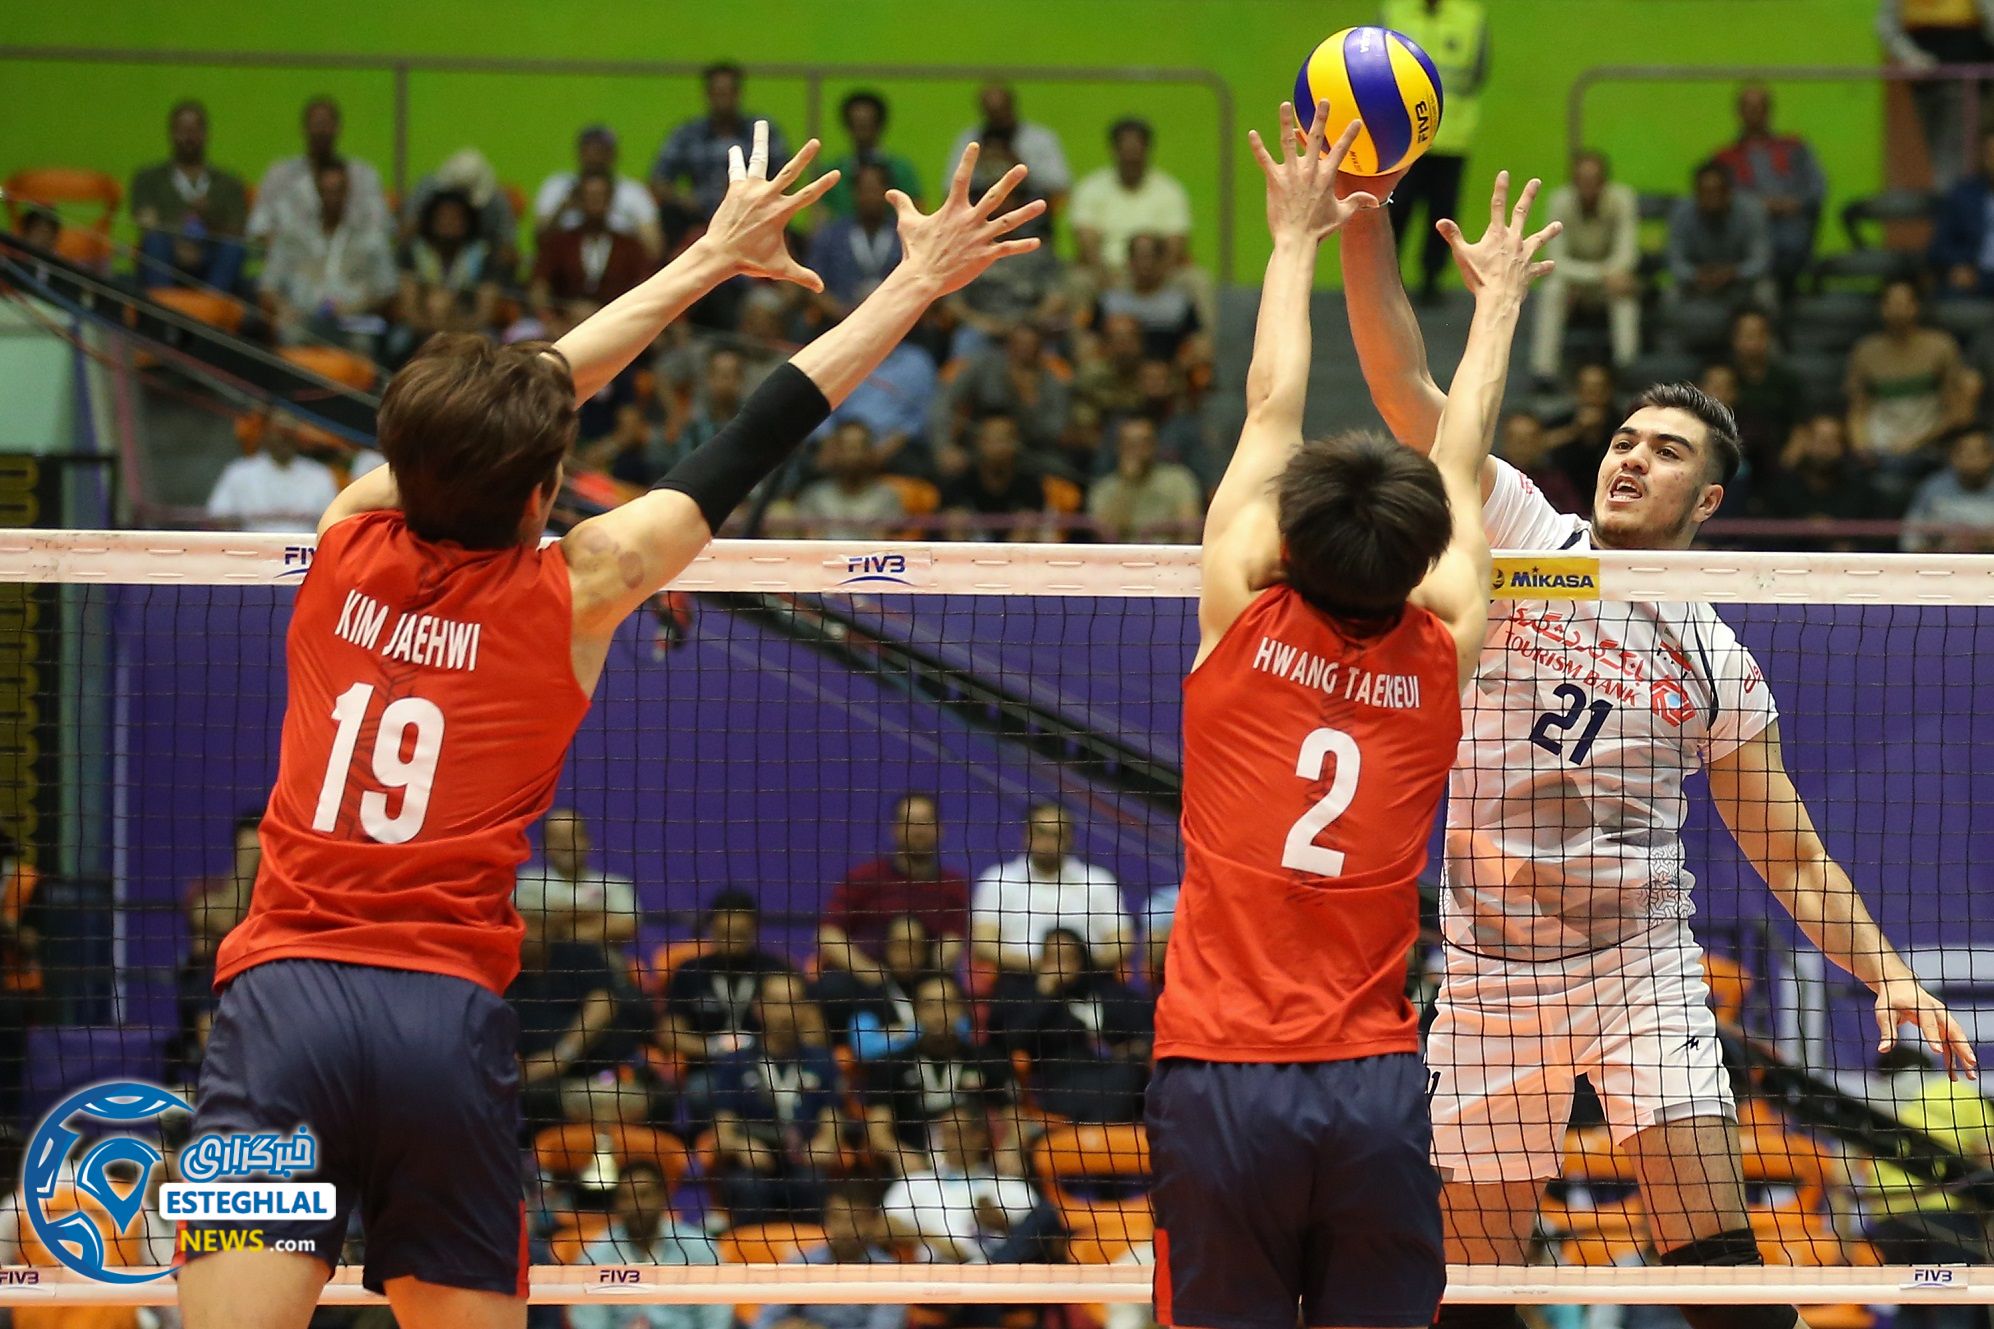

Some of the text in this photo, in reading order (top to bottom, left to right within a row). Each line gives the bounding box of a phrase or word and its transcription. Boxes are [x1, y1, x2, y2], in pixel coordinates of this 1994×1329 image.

[1415, 100, 1428, 144] FIVB
[848, 555, 905, 573] FIVB
[1511, 566, 1594, 588] MIKASA
[335, 589, 481, 672] KIM JAEHWI
[1253, 637, 1421, 709] HWANG TAEKEUI
[1506, 630, 1637, 707] TOURISM BANK
[1529, 683, 1614, 766] 21
[312, 682, 445, 844] 19
[1281, 727, 1361, 878] 2
[0, 1271, 39, 1285] FIVB
[600, 1269, 640, 1283] FIVB
[1914, 1269, 1953, 1282] FIVB
